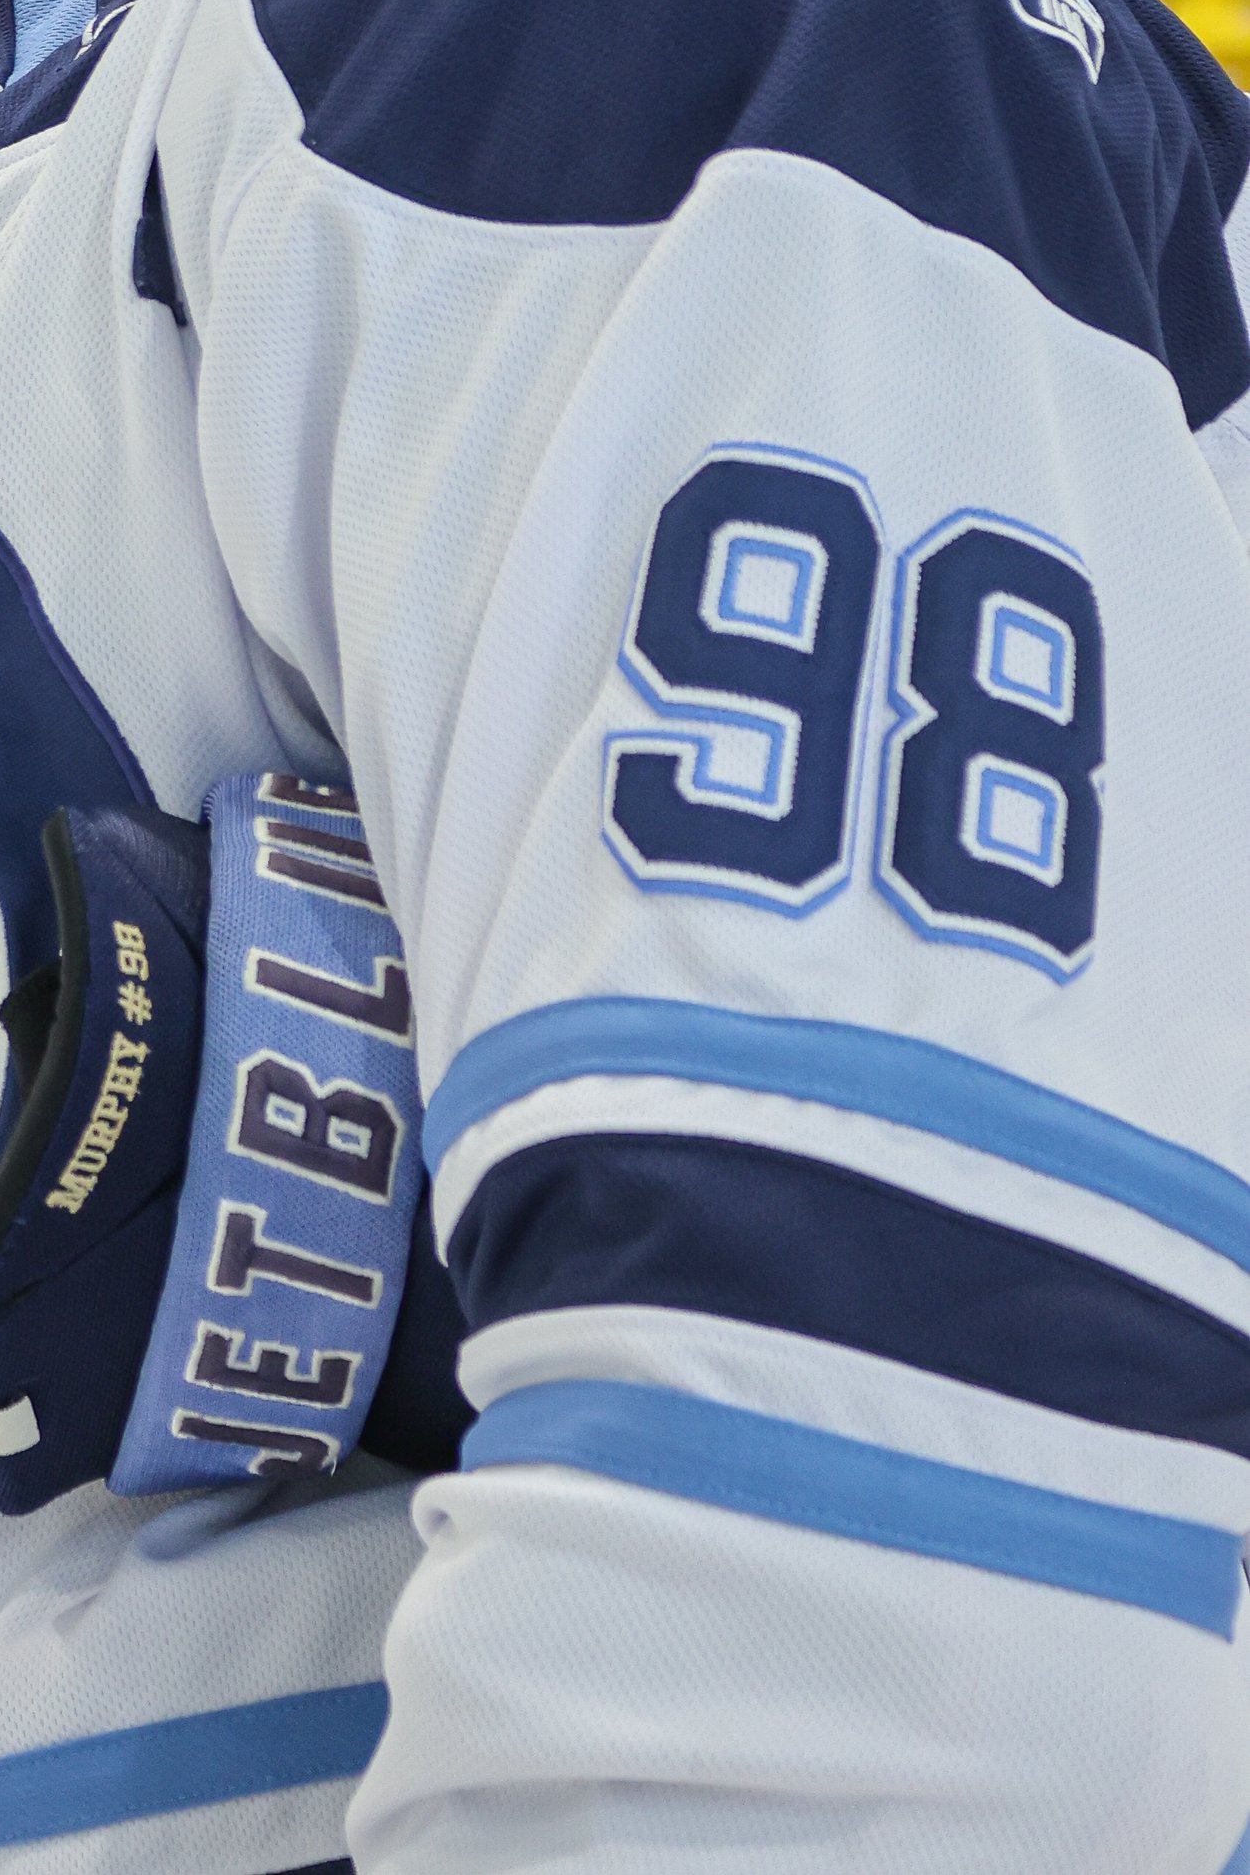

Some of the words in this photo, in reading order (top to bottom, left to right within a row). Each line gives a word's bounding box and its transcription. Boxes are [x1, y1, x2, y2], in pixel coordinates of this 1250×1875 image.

[601, 441, 1107, 987] 98
[45, 1030, 151, 1215] MURPHY
[111, 919, 152, 1026] #98
